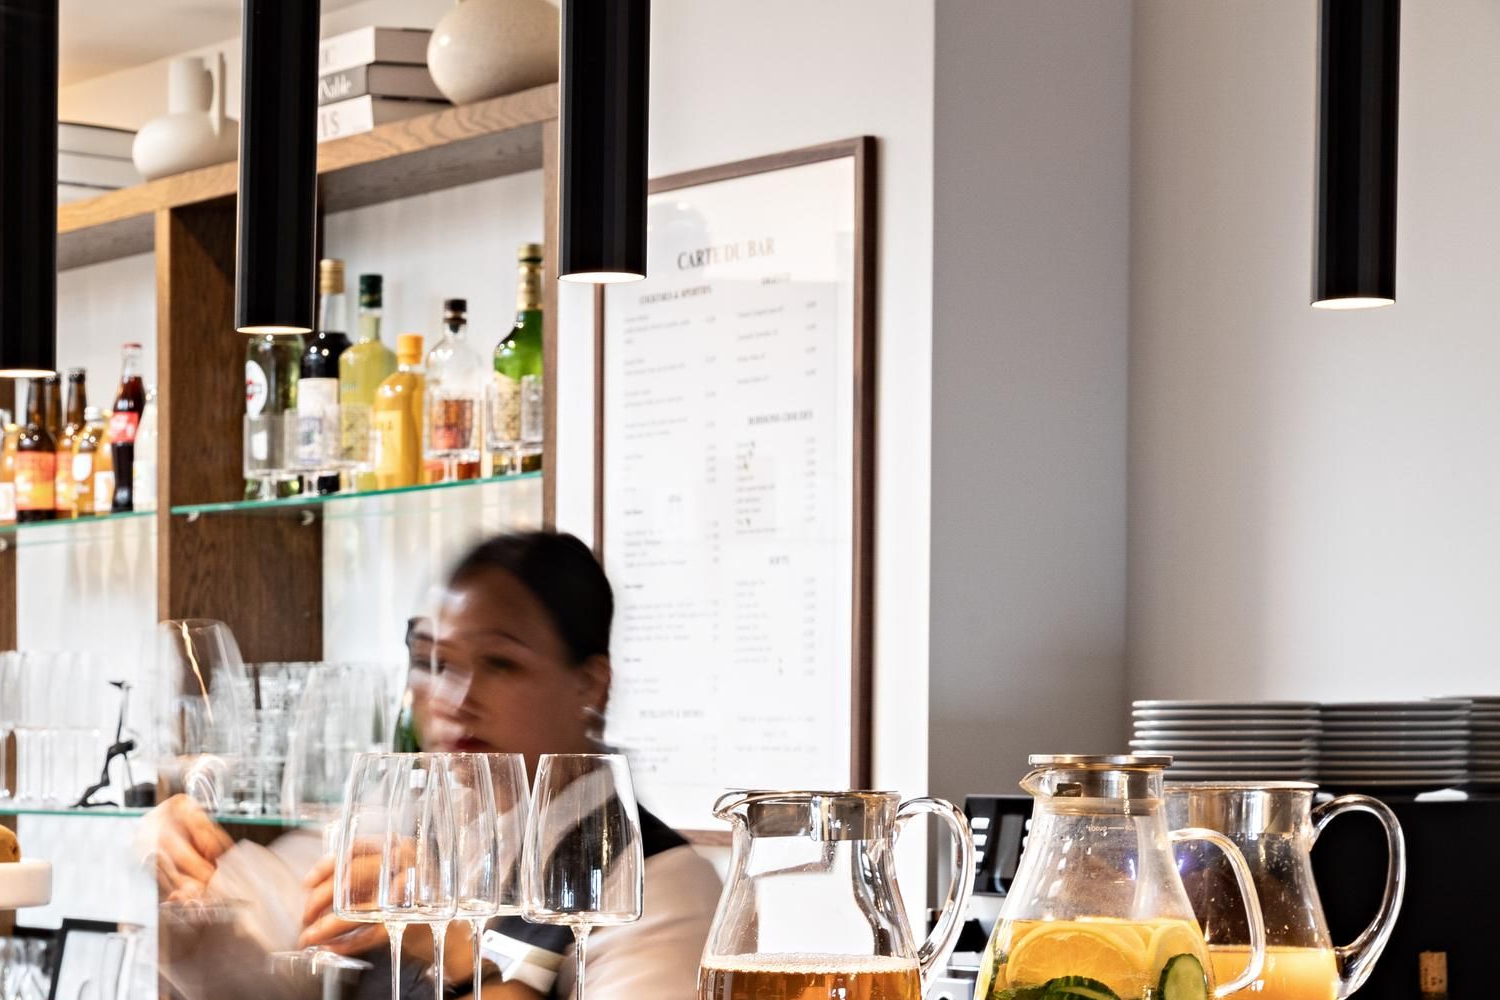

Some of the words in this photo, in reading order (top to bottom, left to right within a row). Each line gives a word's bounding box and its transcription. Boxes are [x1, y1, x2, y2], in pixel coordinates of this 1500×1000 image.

[677, 246, 722, 271] CARTE
[723, 241, 741, 263] DU
[746, 237, 775, 258] BAR
